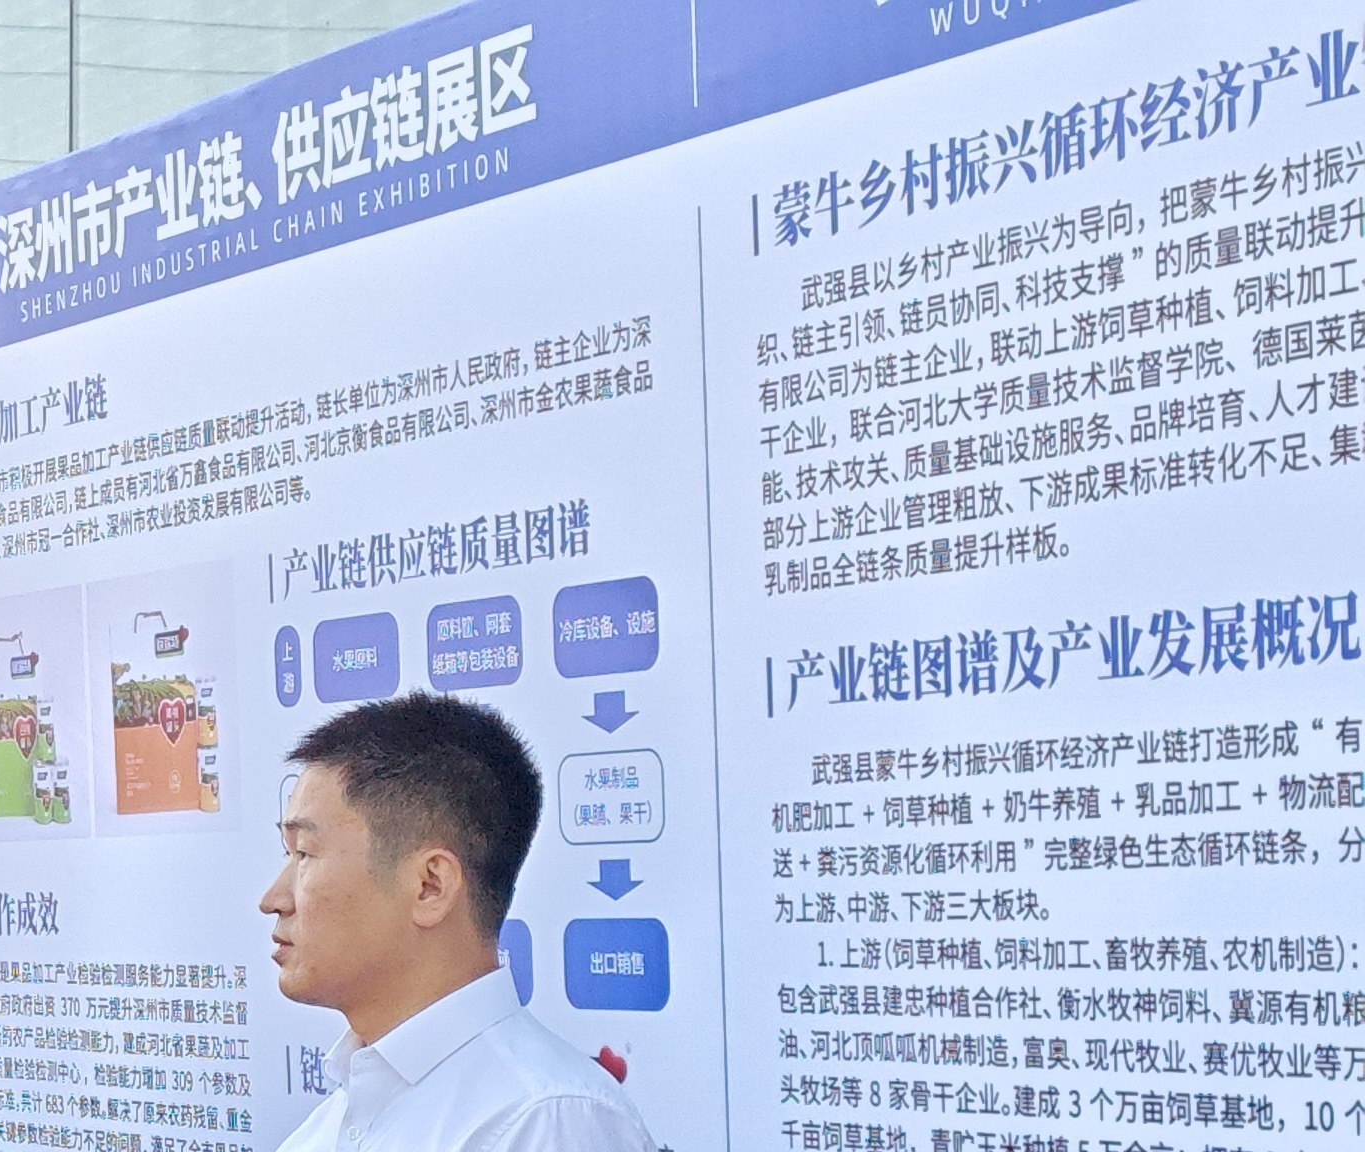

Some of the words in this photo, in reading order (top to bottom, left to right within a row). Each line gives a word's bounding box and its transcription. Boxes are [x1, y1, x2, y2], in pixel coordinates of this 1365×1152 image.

[772, 27, 1365, 248] 蒙牛乡村振兴循环经济产业
[20, 269, 124, 324] SHENZHOU
[132, 222, 260, 288] INDUSTRIAL
[273, 188, 345, 245] CHAIN
[358, 147, 511, 218] EXHIBITION
[759, 258, 1365, 414] 有限公司为链主企业，联动上游饲草种植、饲料加工
[761, 366, 1365, 505] 能、技术攻关、质量基础设施服务、品牌培育、人才建
[763, 422, 1365, 551] 部分上游企业管理粗放、下游成果标准转化不足、集
[283, 498, 590, 600] 产业链供应链质量图谱
[764, 523, 1070, 597] 乳制品全链条质量提升样板。
[786, 590, 1362, 712] 产业链图谱及产业发展概况
[774, 889, 1050, 924] 为上游、中游、下游三大板块。
